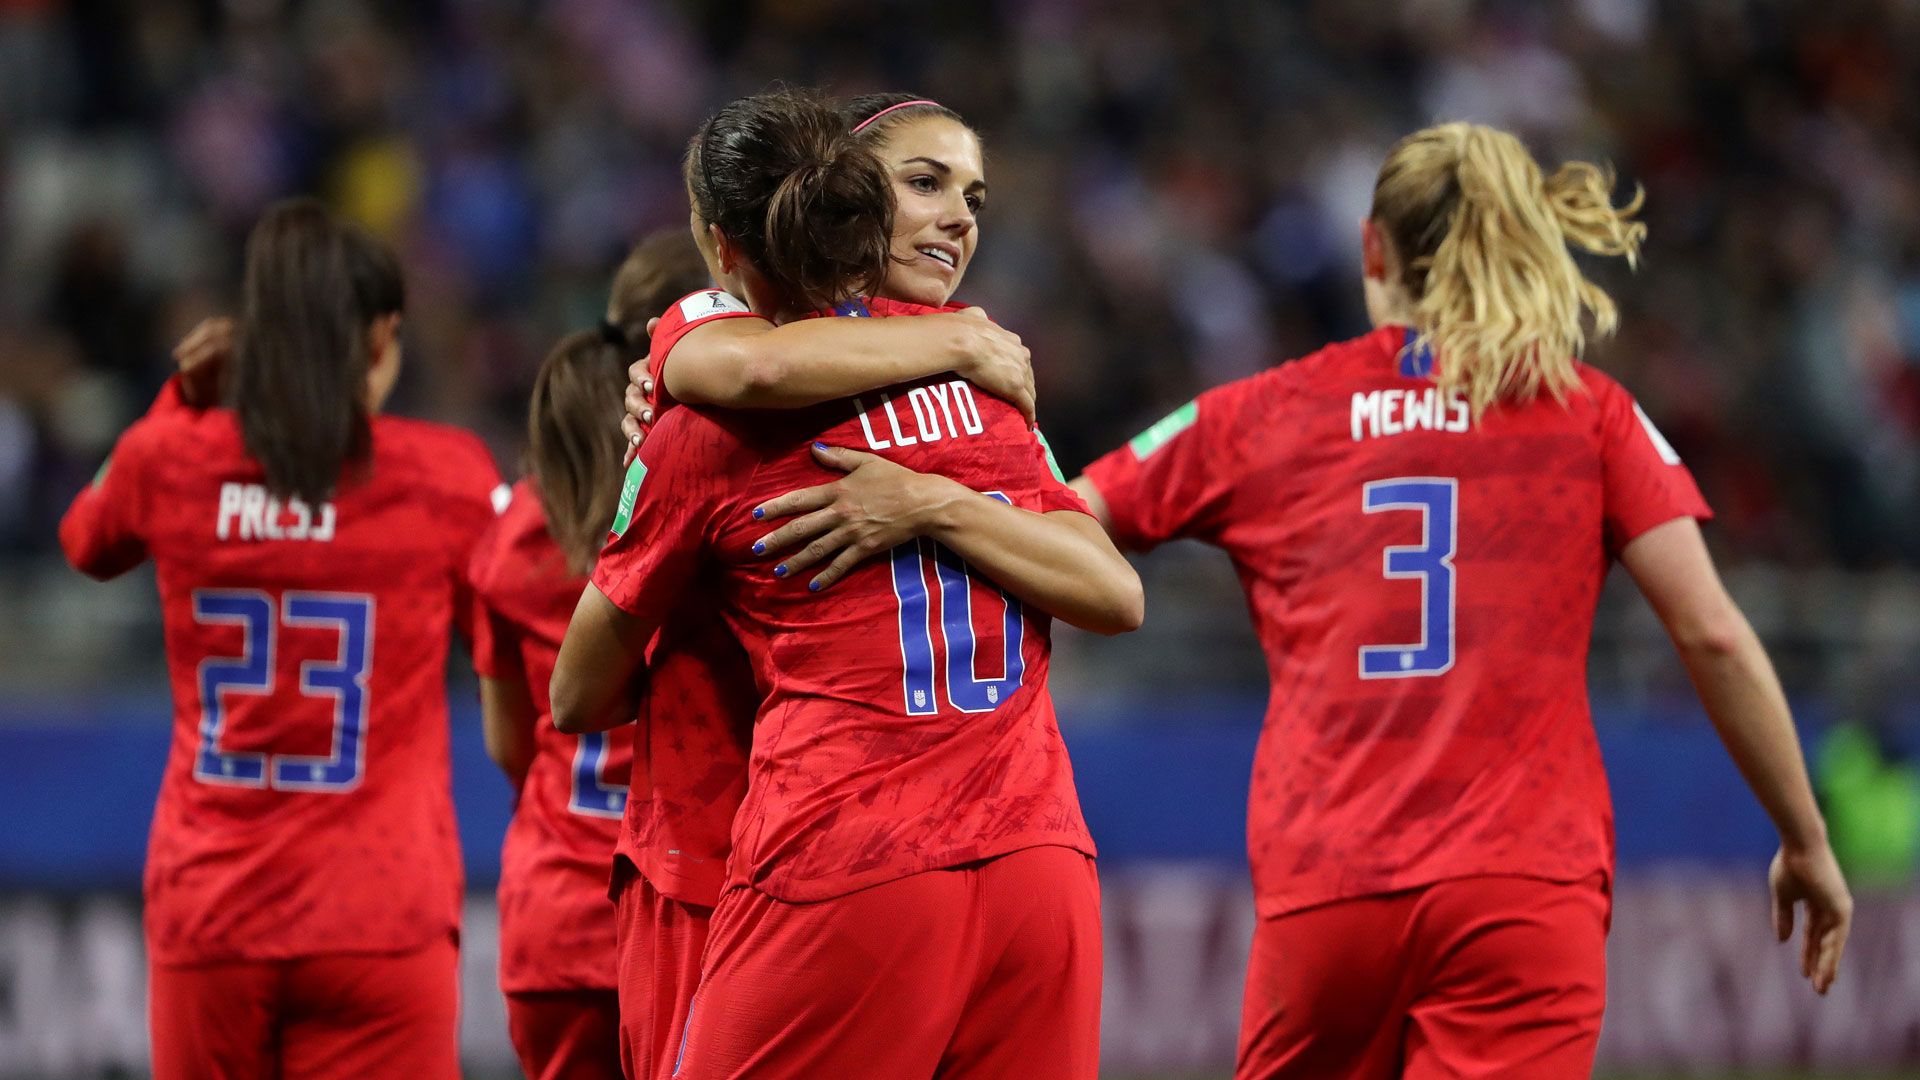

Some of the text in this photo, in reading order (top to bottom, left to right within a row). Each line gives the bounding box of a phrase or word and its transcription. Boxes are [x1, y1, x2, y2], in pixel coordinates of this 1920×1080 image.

[853, 379, 984, 450] LLOYD
[1351, 387, 1470, 442] MEWIS
[890, 490, 1026, 716] 10
[1358, 475, 1458, 680] 3
[192, 587, 375, 794] 23
